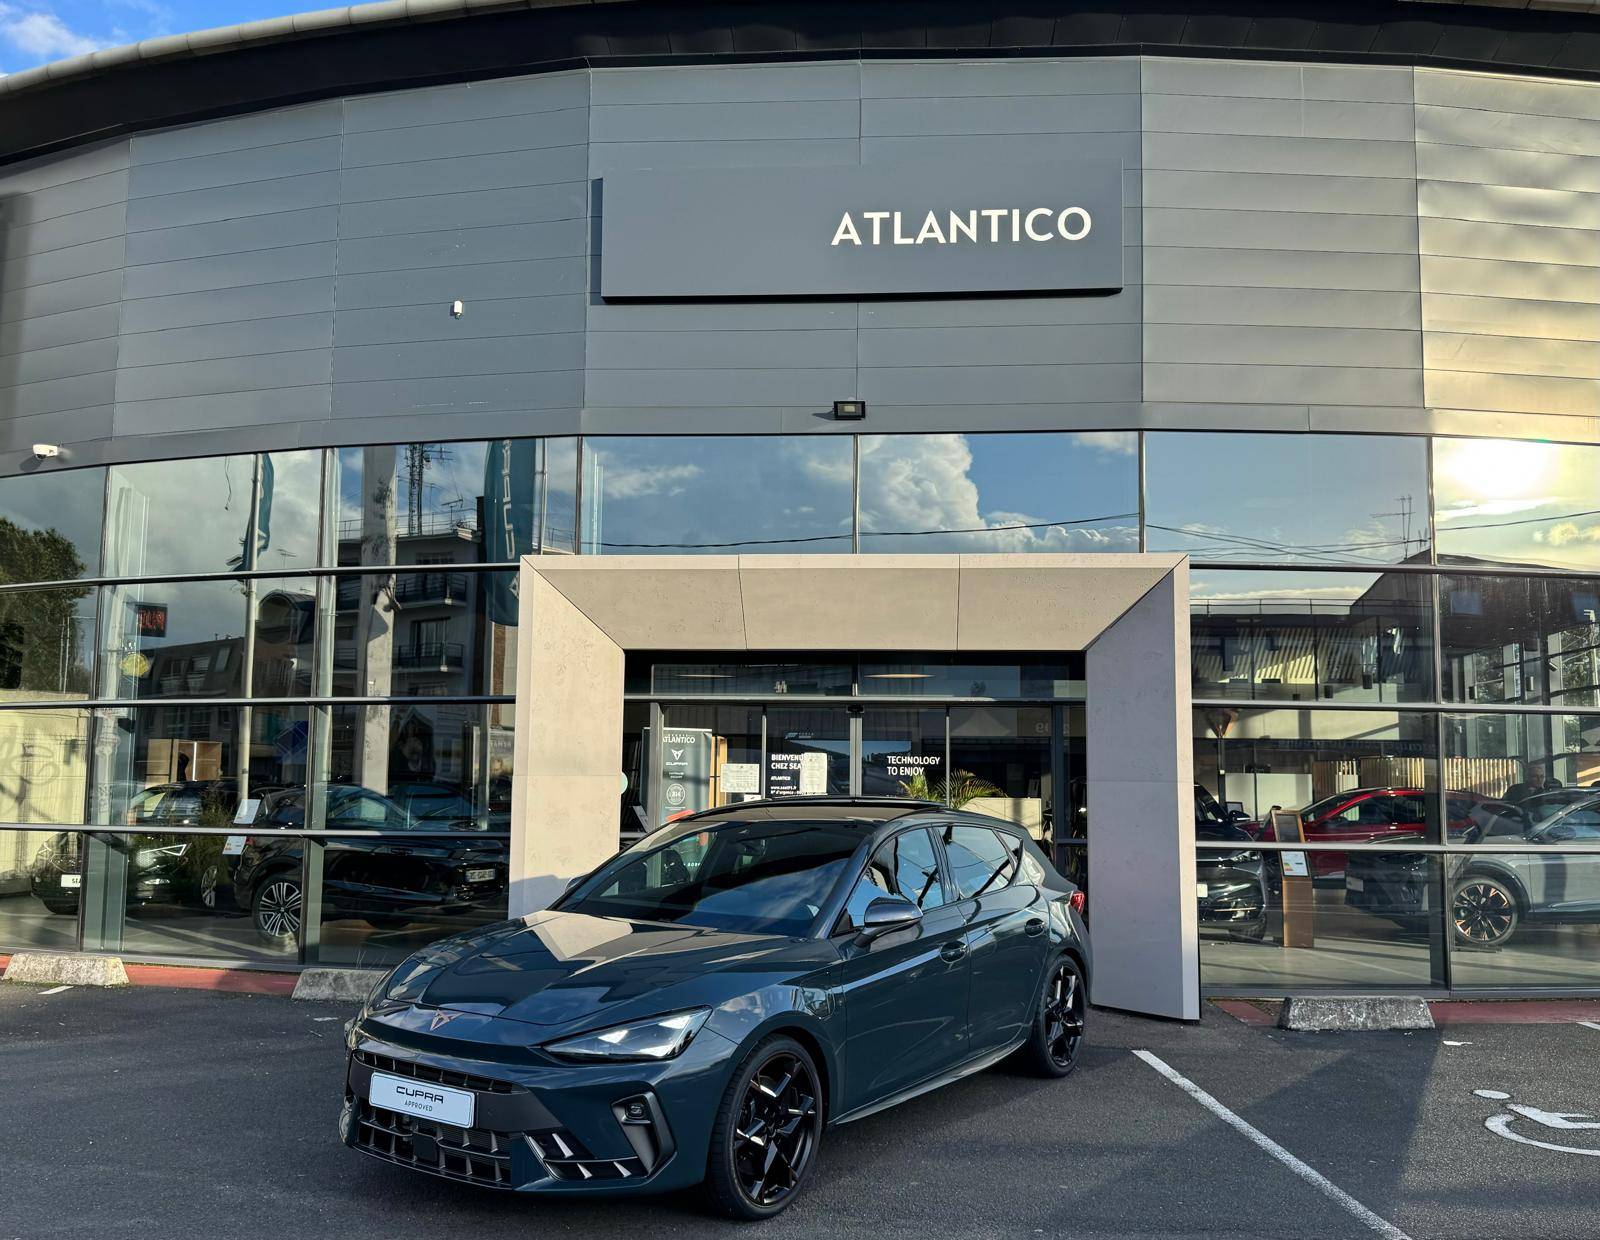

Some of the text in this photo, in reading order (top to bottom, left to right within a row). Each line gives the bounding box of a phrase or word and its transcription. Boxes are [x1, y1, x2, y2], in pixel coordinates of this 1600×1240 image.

[831, 207, 1092, 246] ATLANTICO
[771, 753, 805, 762] BIENVENU
[887, 755, 941, 765] TECHNOLOGY
[771, 762, 802, 770] CHEZ SEA
[887, 766, 925, 777] TO ENJOY
[396, 1085, 444, 1104] CUPRA
[404, 1099, 433, 1112] APPROVED
